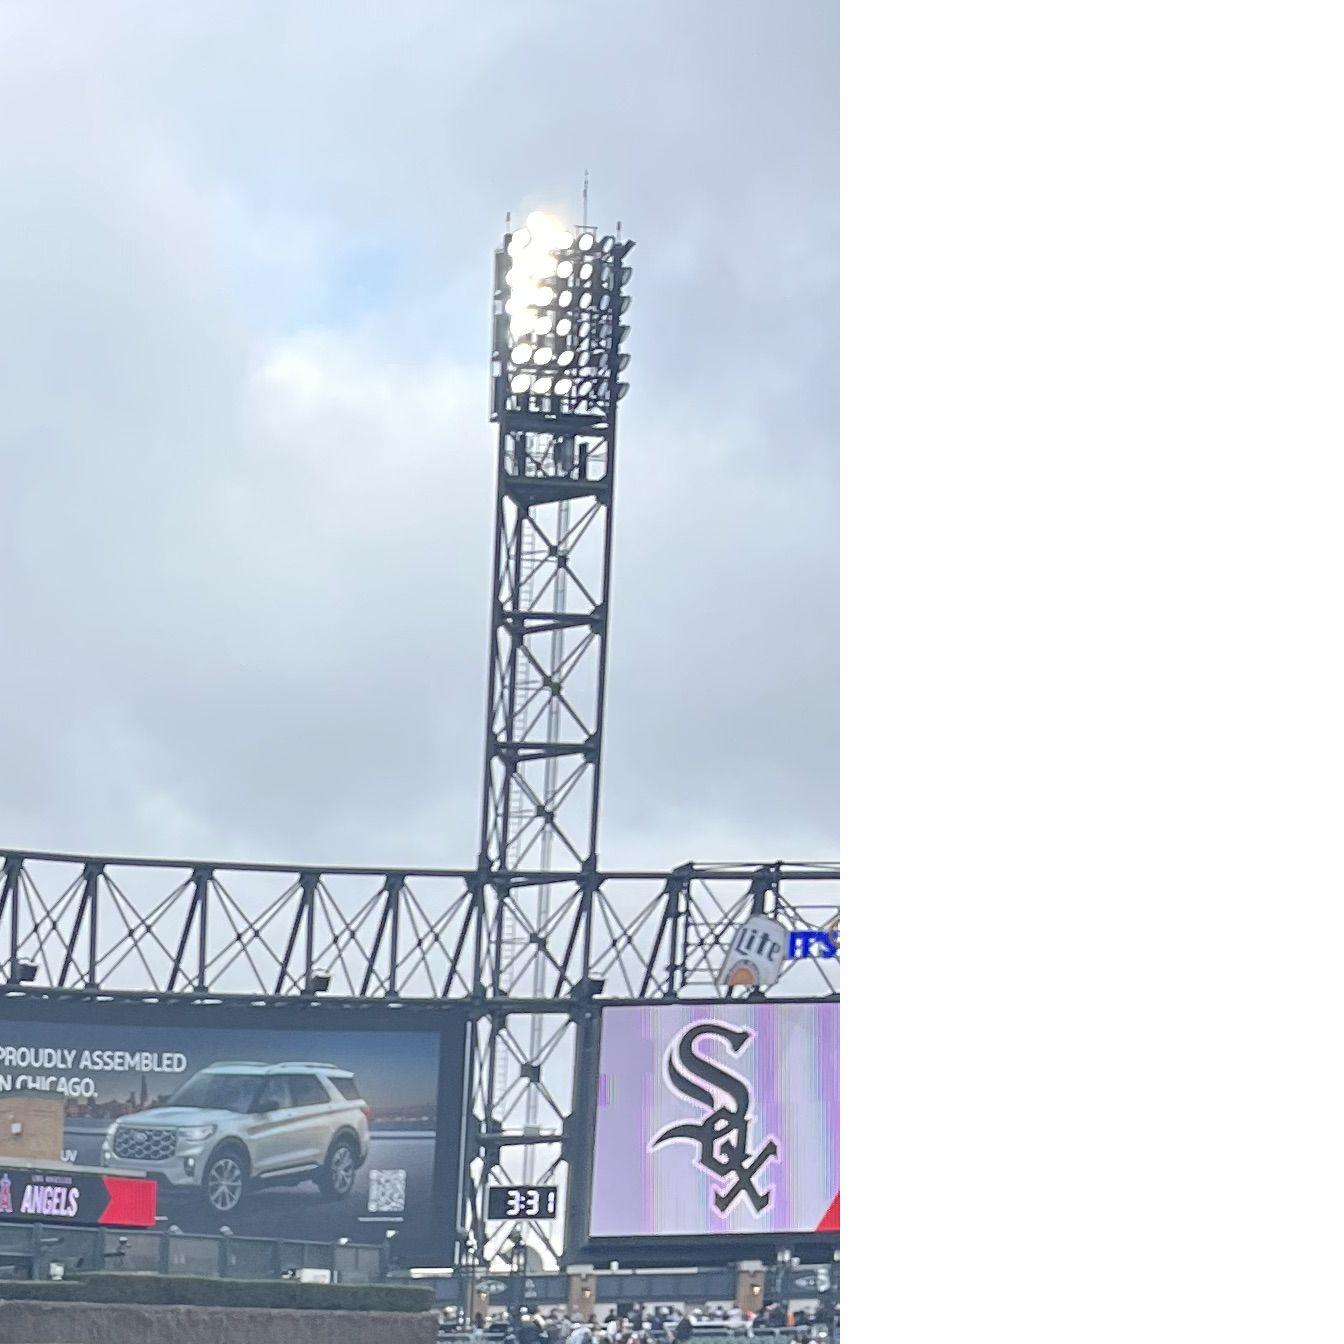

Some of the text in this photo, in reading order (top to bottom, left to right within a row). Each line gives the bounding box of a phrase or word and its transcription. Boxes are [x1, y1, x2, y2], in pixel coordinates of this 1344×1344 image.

[735, 927, 781, 961] Lite
[79, 1050, 187, 1073] ASSEMBLED
[21, 1185, 80, 1218] ANGELS
[506, 1190, 556, 1216] 3:31
